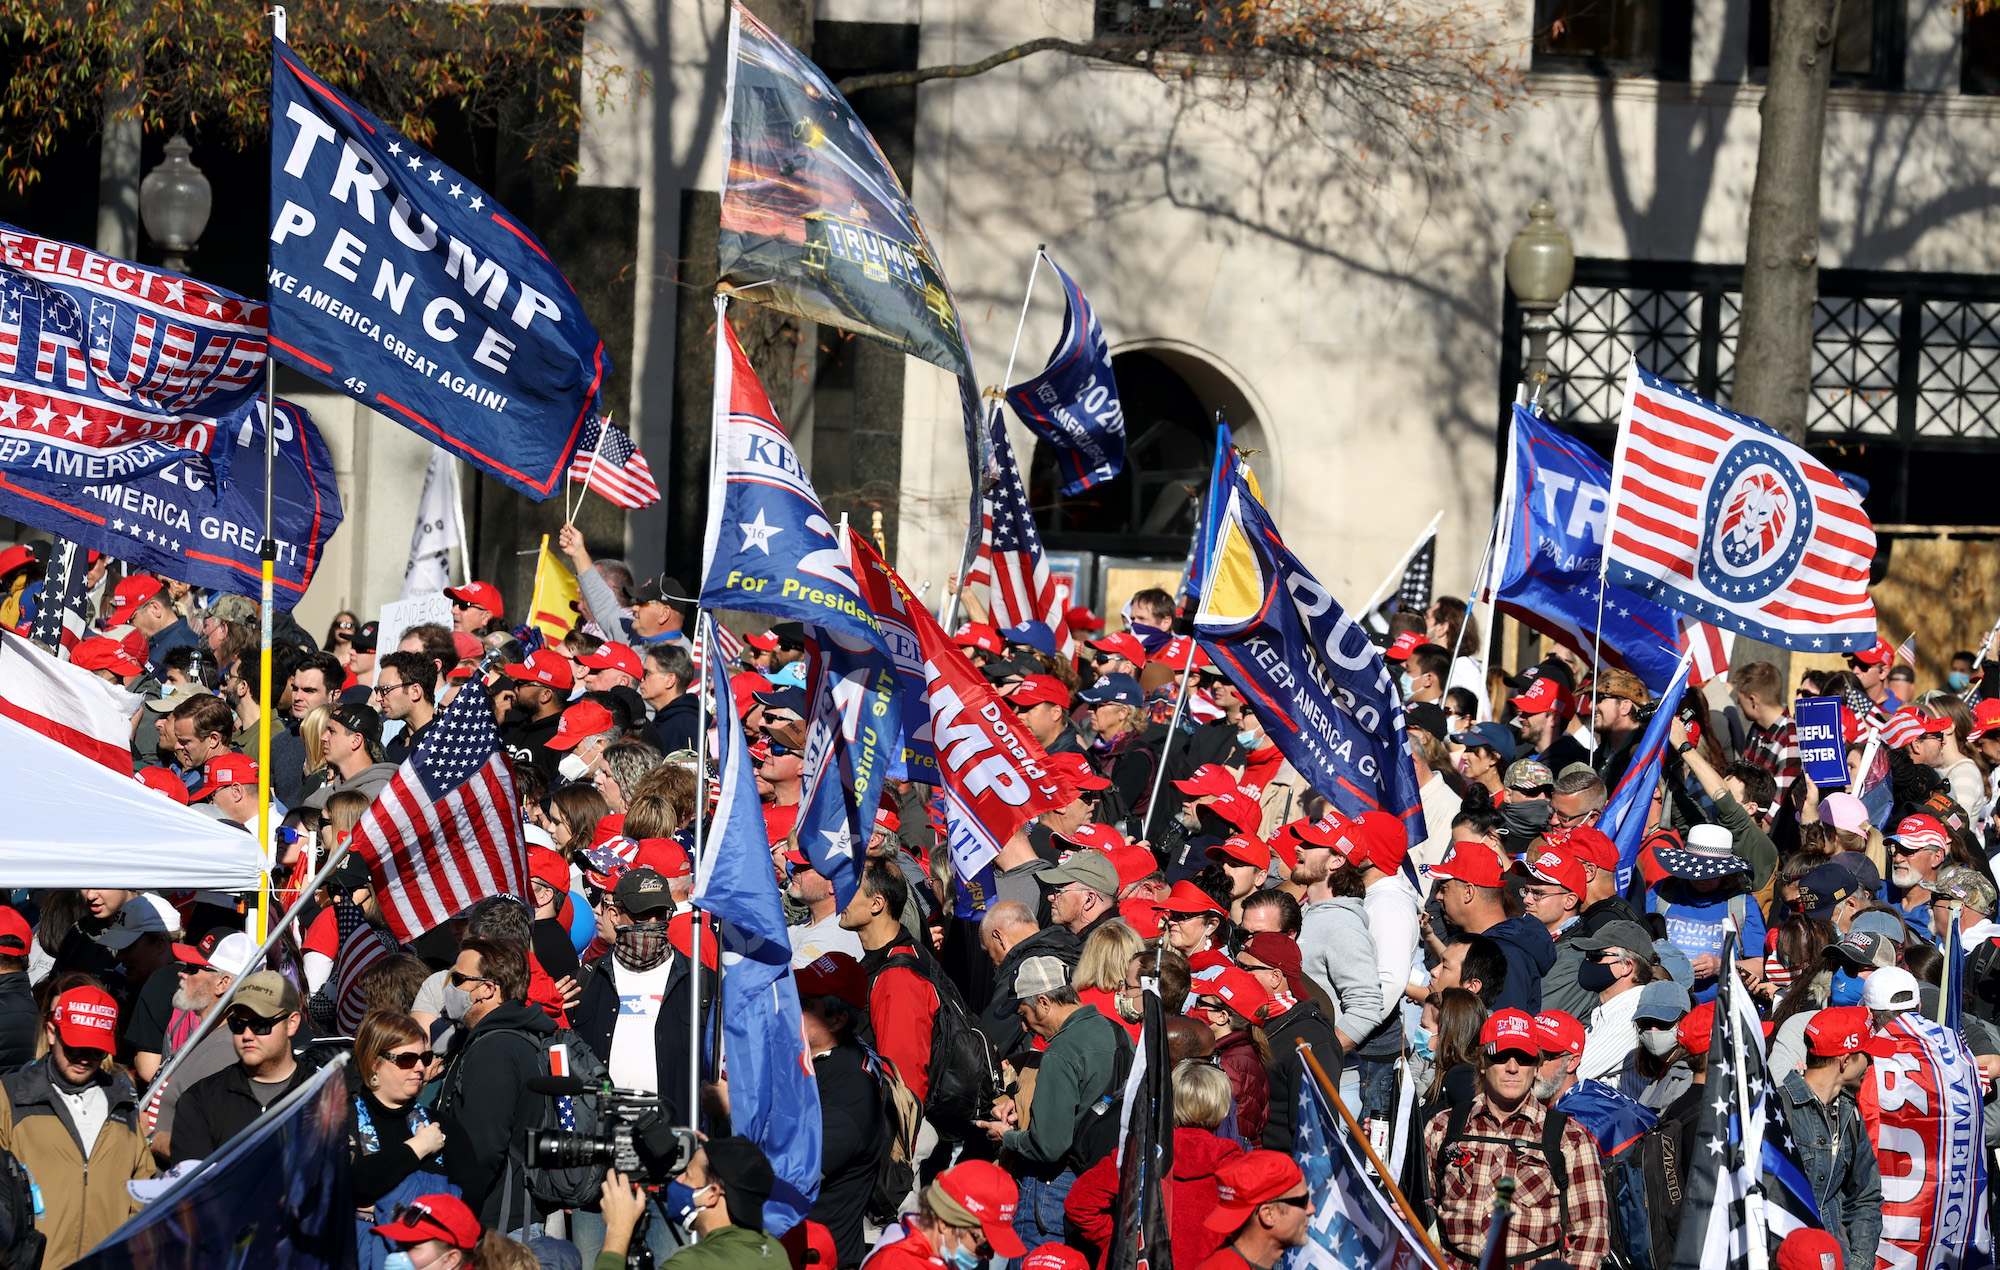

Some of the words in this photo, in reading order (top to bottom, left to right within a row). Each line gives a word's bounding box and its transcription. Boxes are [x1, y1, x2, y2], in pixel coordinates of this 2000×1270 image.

[284, 101, 561, 330] TRUMP
[0, 233, 161, 298] E-ELECT
[828, 224, 919, 272] TRUMP
[270, 200, 517, 374] PENCE
[0, 269, 267, 414] TRUMP
[298, 285, 380, 341] AMERICA
[384, 333, 438, 377] GREAT
[438, 371, 508, 413] AGAIN!
[344, 376, 367, 394] 45
[32, 441, 166, 479] AMERICA
[726, 571, 768, 593] For
[782, 577, 883, 635] President
[1244, 634, 1296, 689] KEEP
[1293, 687, 1353, 763] AMERICA
[980, 701, 1046, 780] Donald
[1039, 784, 1058, 800] J.
[1666, 918, 1722, 937] TRUMP
[67, 1001, 91, 1013] MAKE
[90, 1003, 117, 1018] AMERICA
[70, 1014, 95, 1027] GREAT
[95, 1015, 114, 1030] AGAIN
[1844, 1034, 1859, 1049] 45
